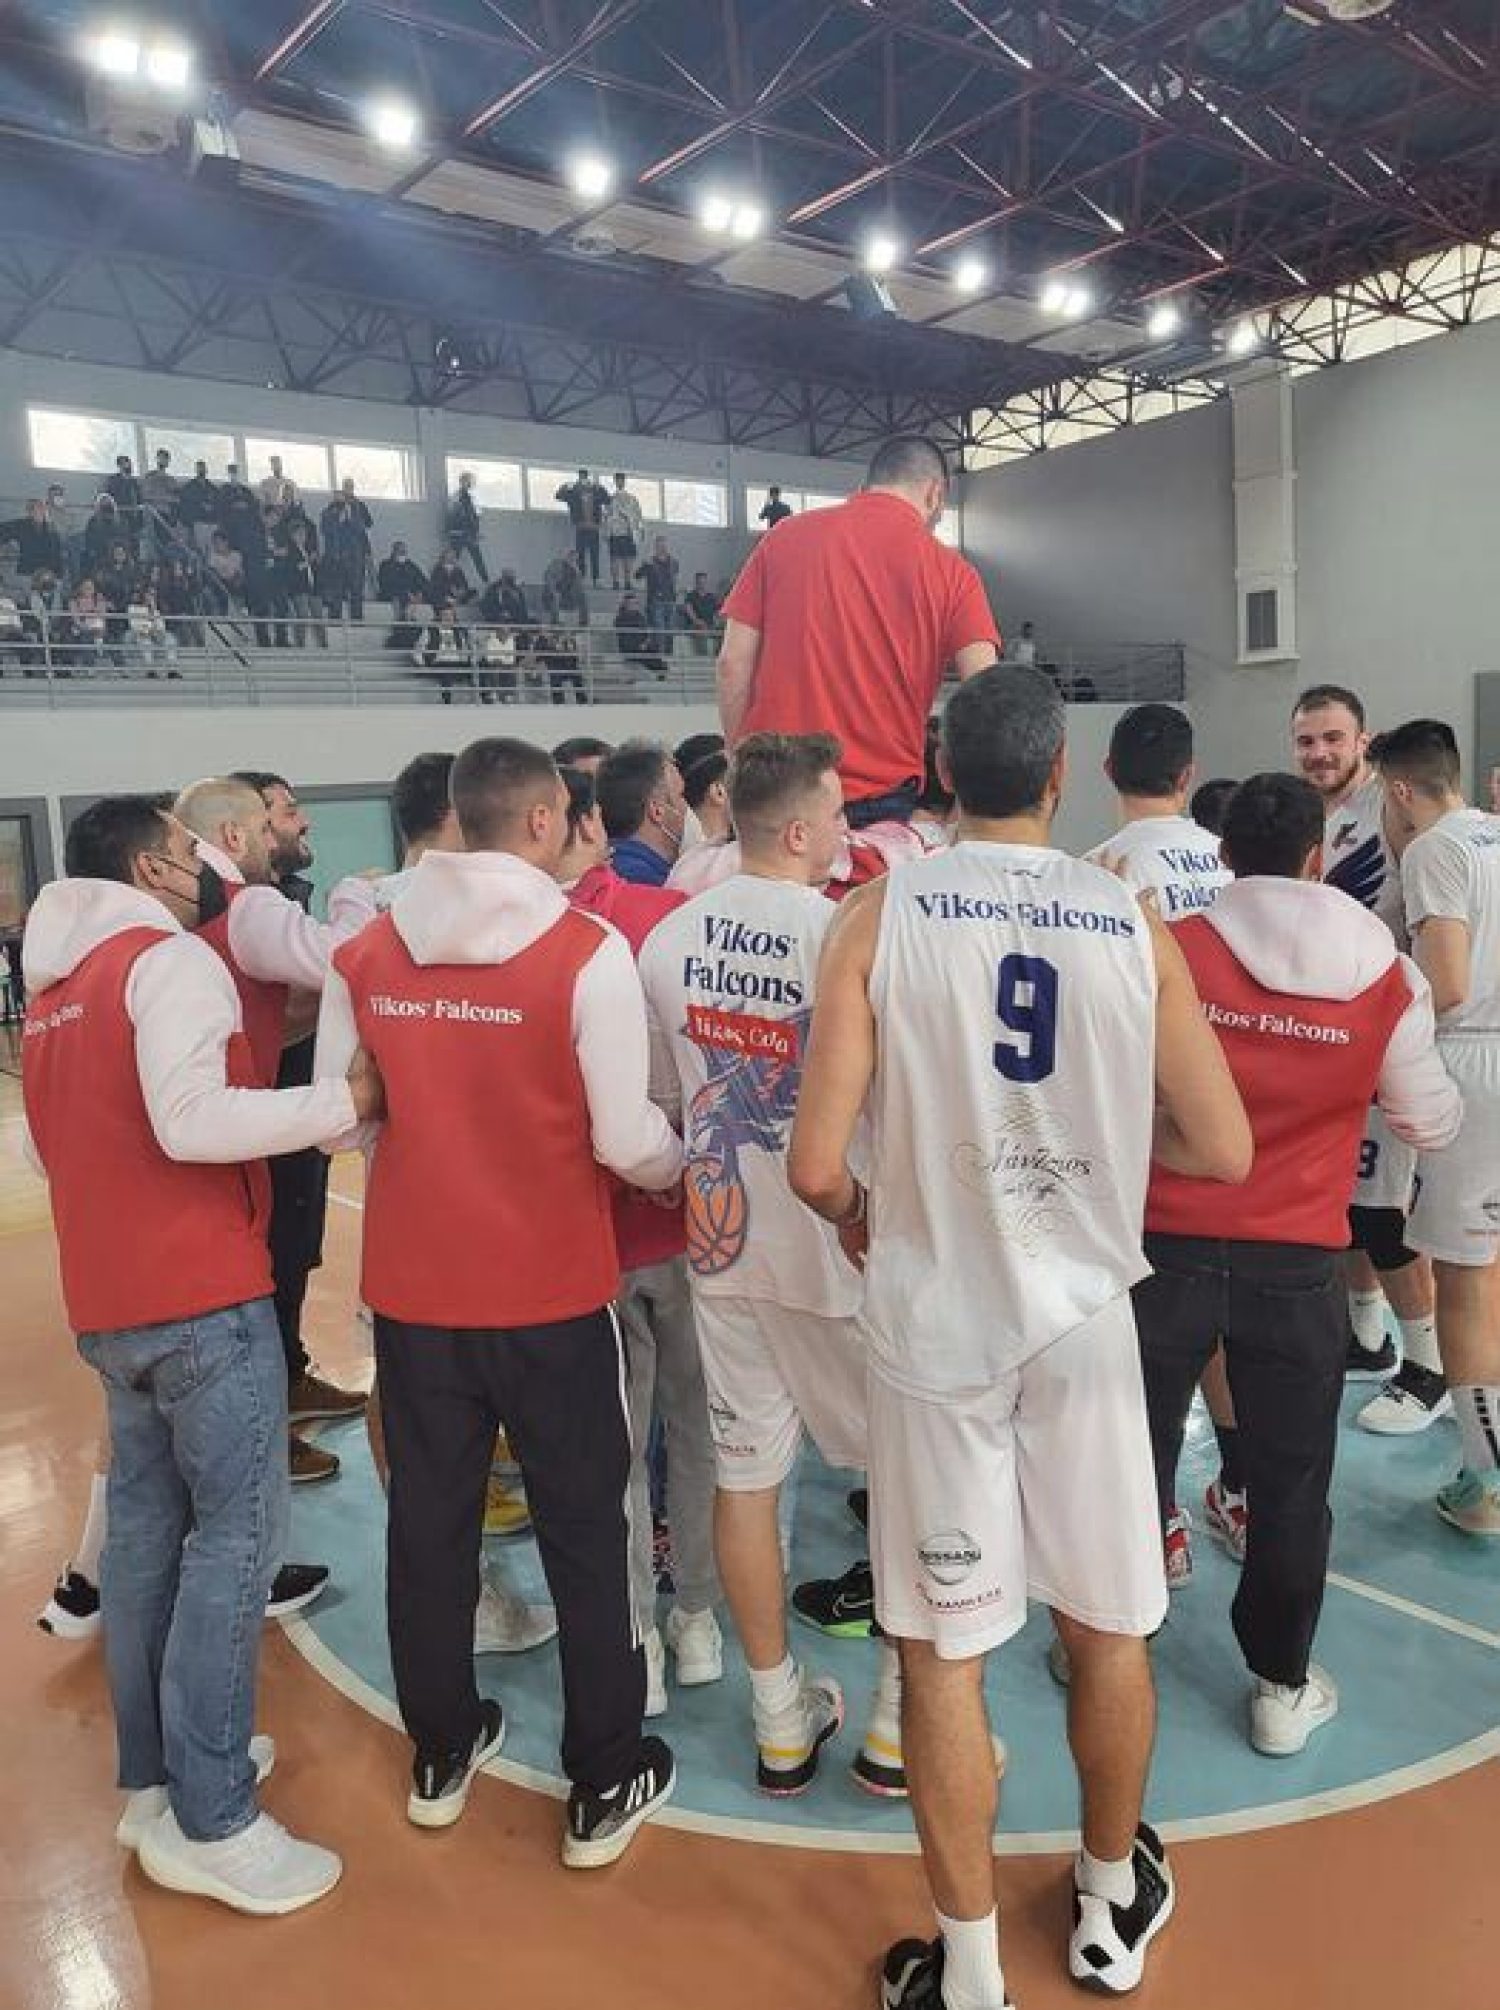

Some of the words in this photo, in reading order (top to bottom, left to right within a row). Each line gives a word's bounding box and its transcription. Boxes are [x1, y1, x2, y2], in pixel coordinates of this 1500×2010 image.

[1158, 848, 1219, 873] Viko
[915, 891, 1010, 920] Vikos
[1016, 900, 1136, 938] Falcons
[705, 916, 793, 959] Vikos
[684, 957, 804, 1005] Falcons
[434, 999, 523, 1025] Falcons
[993, 954, 1059, 1083] 9
[1259, 1014, 1350, 1045] Falcons
